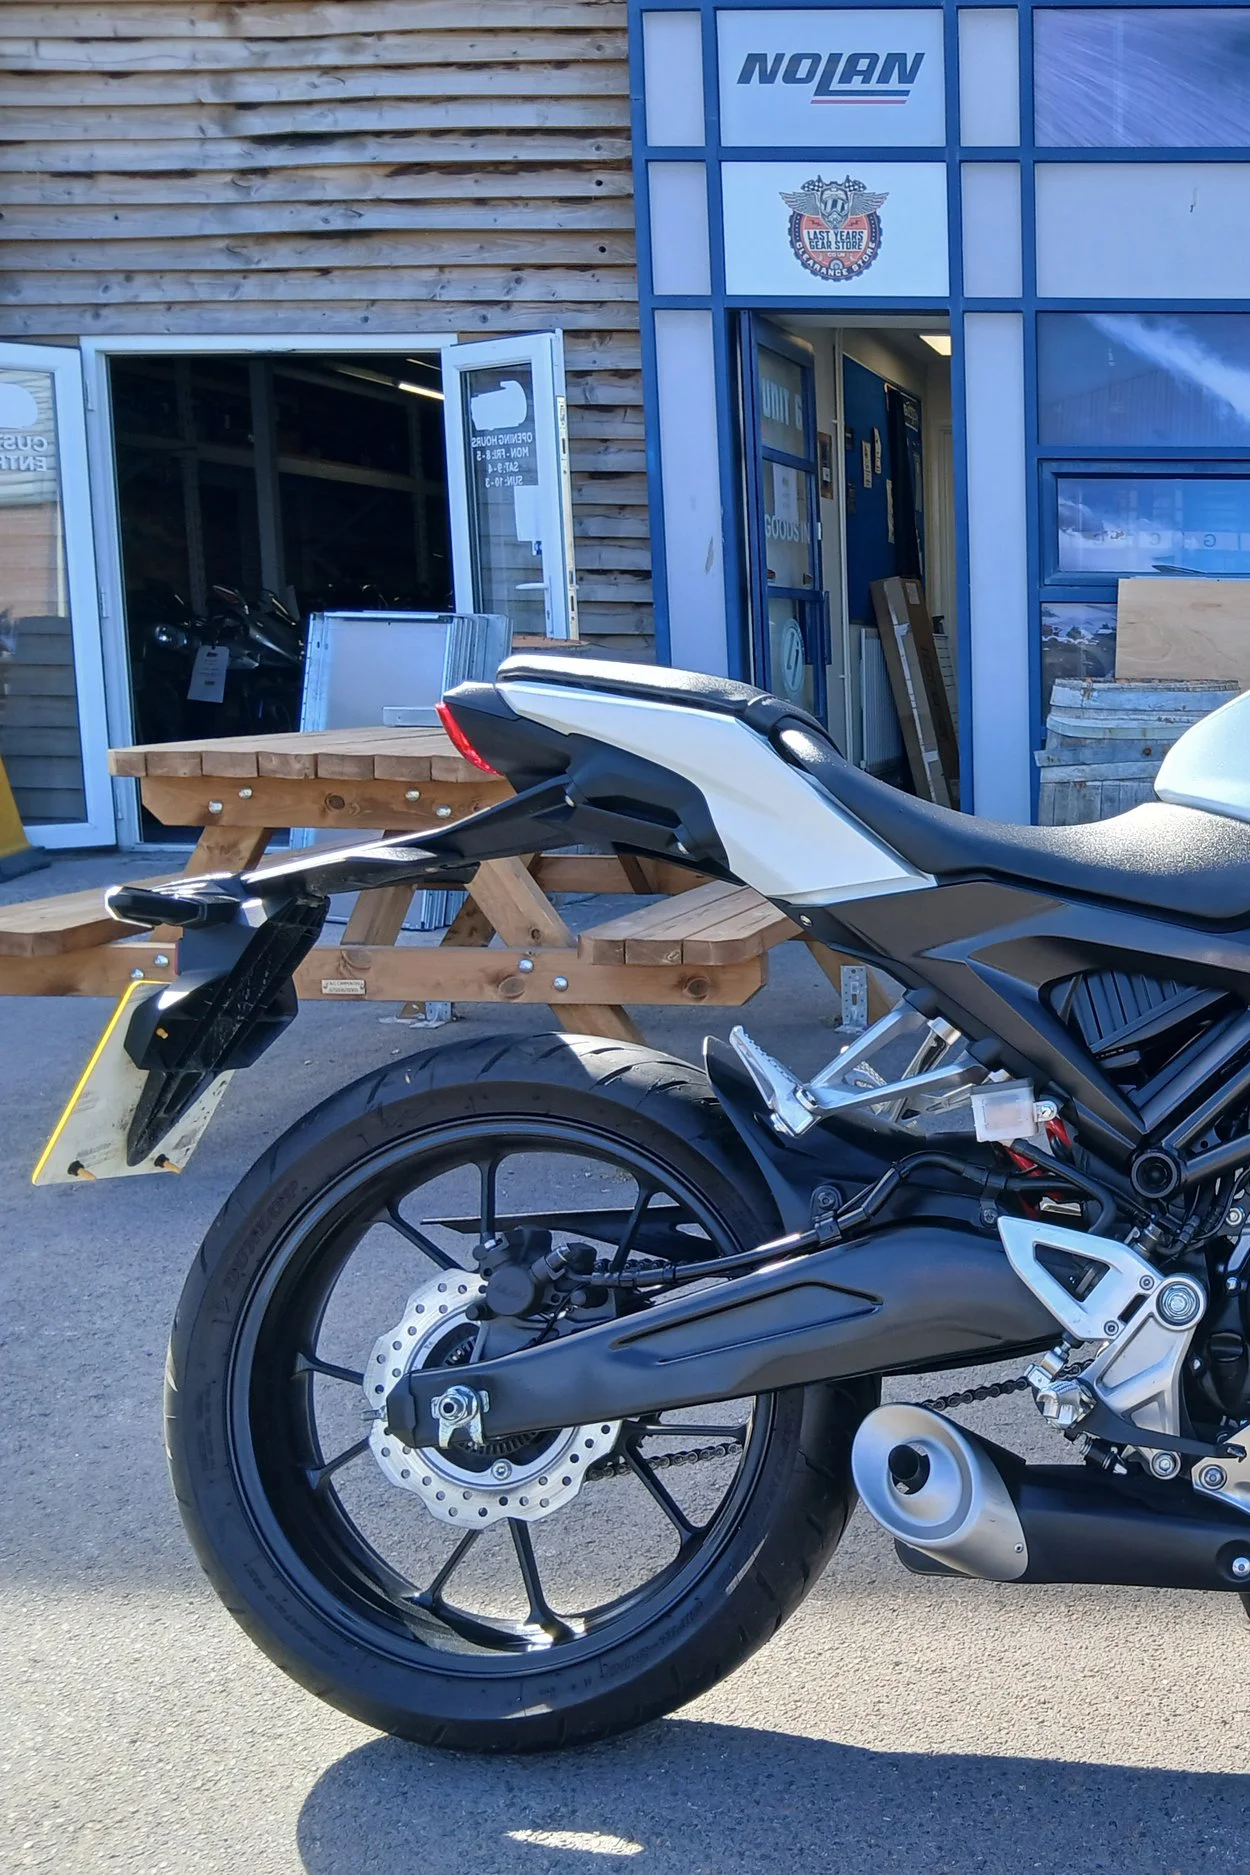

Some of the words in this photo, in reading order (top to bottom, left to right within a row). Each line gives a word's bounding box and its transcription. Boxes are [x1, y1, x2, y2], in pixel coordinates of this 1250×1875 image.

[736, 52, 925, 97] NOLAN
[807, 230, 830, 241] LAST
[833, 230, 864, 241] YEARS
[809, 240, 832, 250] GEAR
[835, 240, 863, 250] STORE
[796, 242, 849, 276] CLEARANCE
[851, 242, 875, 271] STORE
[762, 377, 789, 426] UNIT
[765, 514, 799, 543] GOODS
